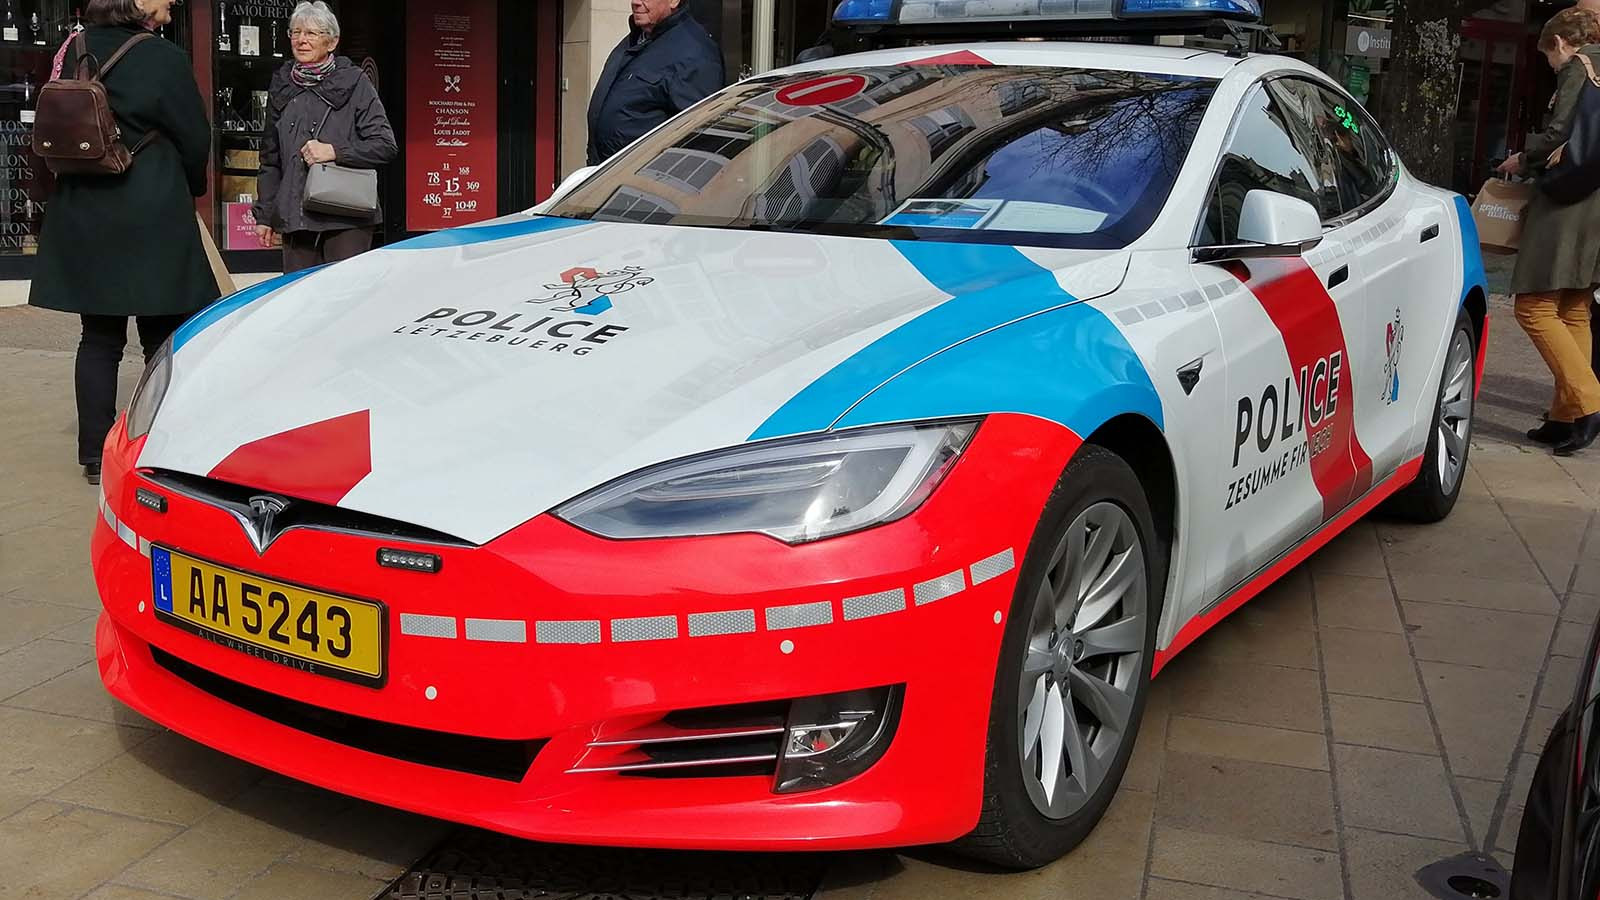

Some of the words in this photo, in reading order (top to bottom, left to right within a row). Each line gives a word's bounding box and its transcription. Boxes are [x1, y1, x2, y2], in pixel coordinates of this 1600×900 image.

[427, 171, 440, 184] 78
[445, 177, 460, 192] 15
[423, 193, 442, 205] 486
[455, 200, 477, 210] 1049
[443, 207, 452, 216] 37
[414, 307, 630, 345] POLICE
[393, 324, 593, 356] LËTZEBUERG
[1232, 350, 1342, 469] POLICE
[1225, 451, 1289, 511] ZESUMME
[1289, 440, 1308, 471] FIR
[160, 584, 168, 601] L
[189, 566, 230, 627] AA
[241, 582, 352, 659] 5243
[198, 629, 268, 660] ALL-WHEEL
[272, 653, 316, 674] DRIVE
